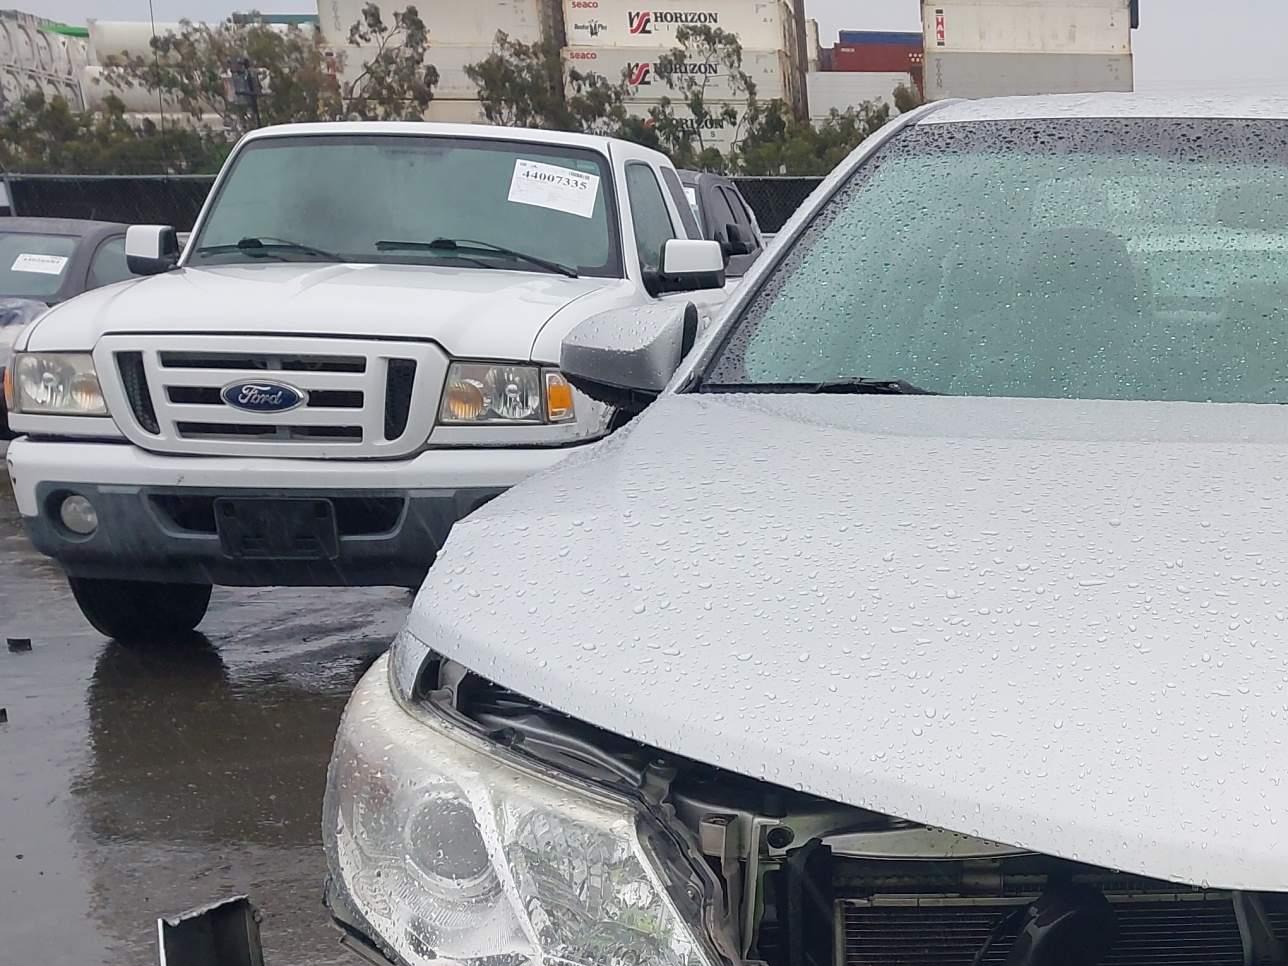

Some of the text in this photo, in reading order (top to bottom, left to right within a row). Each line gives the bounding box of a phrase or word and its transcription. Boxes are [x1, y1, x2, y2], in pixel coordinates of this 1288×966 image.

[572, 0, 598, 8] seaco
[653, 11, 718, 23] HORIZON
[570, 52, 597, 60] seaco
[522, 170, 588, 190] 44007335
[238, 384, 282, 405] Ford
